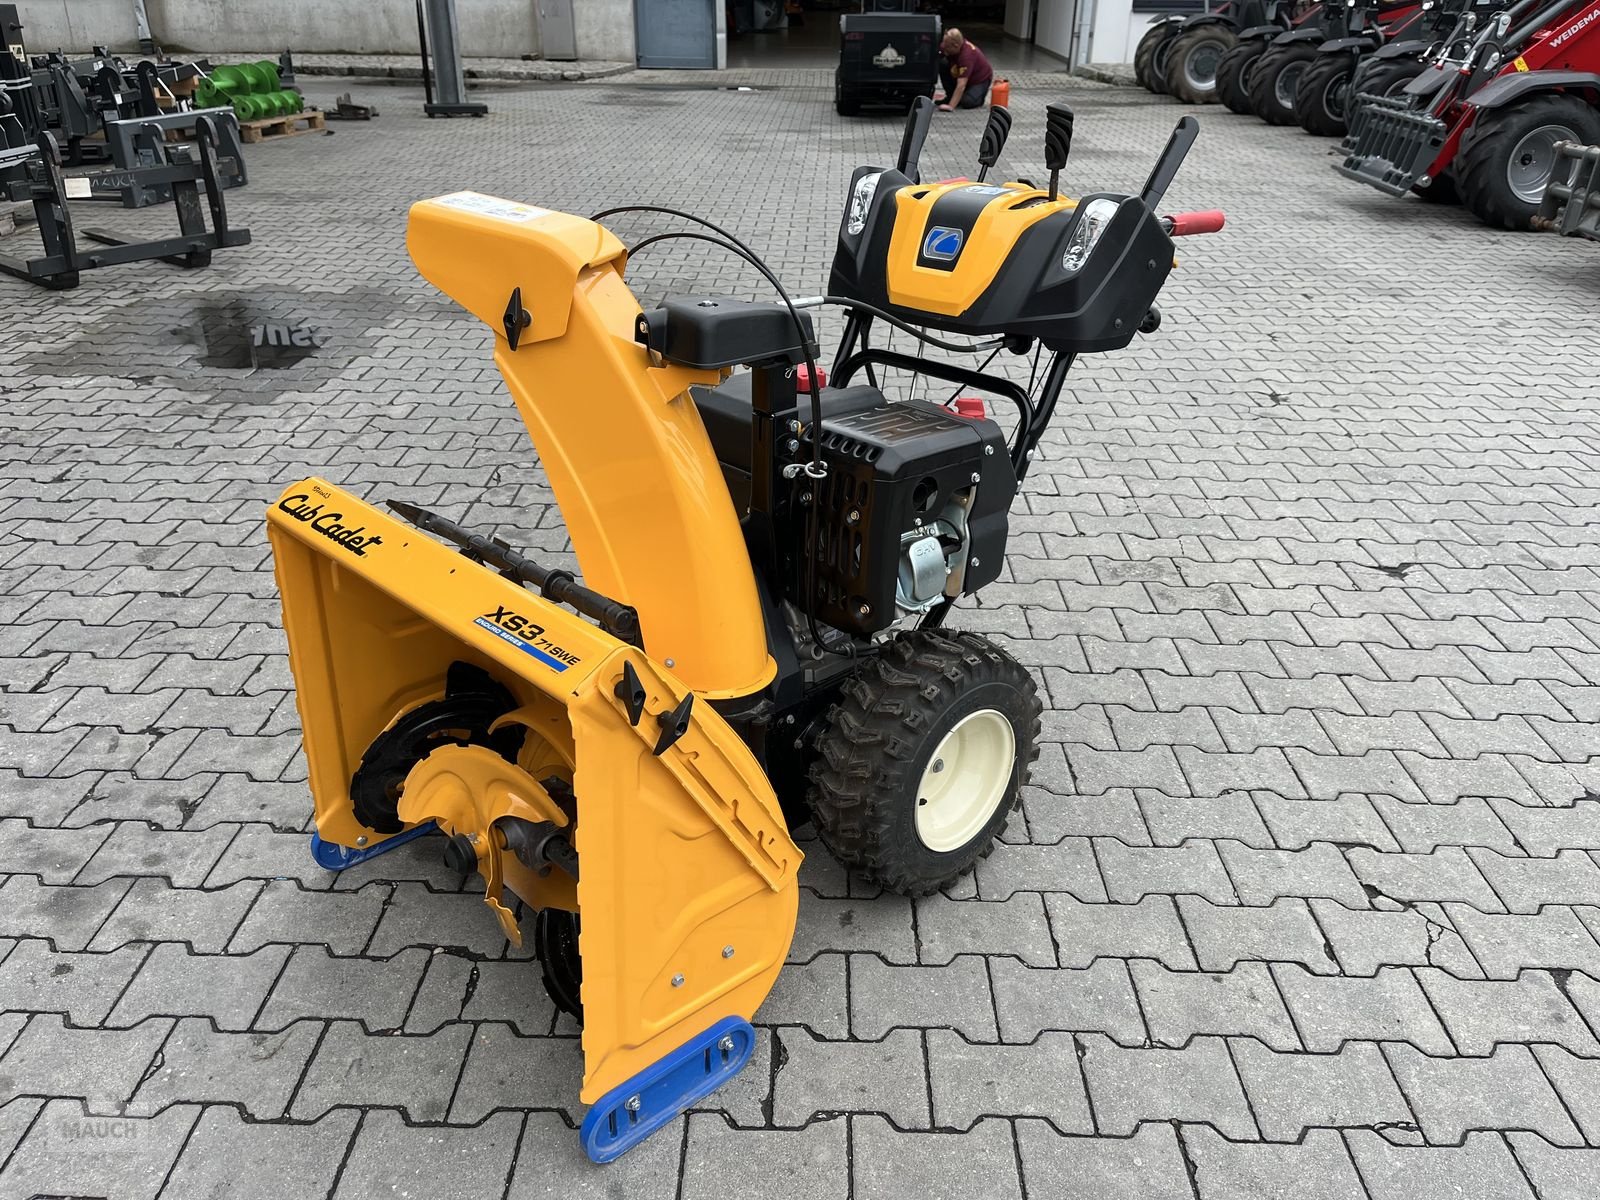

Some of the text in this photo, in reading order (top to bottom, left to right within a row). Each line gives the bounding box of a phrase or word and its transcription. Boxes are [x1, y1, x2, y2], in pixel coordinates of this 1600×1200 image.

[279, 494, 383, 557] Cub Cadet
[475, 618, 523, 647] ENDURO SERIES
[483, 605, 546, 641] XS3
